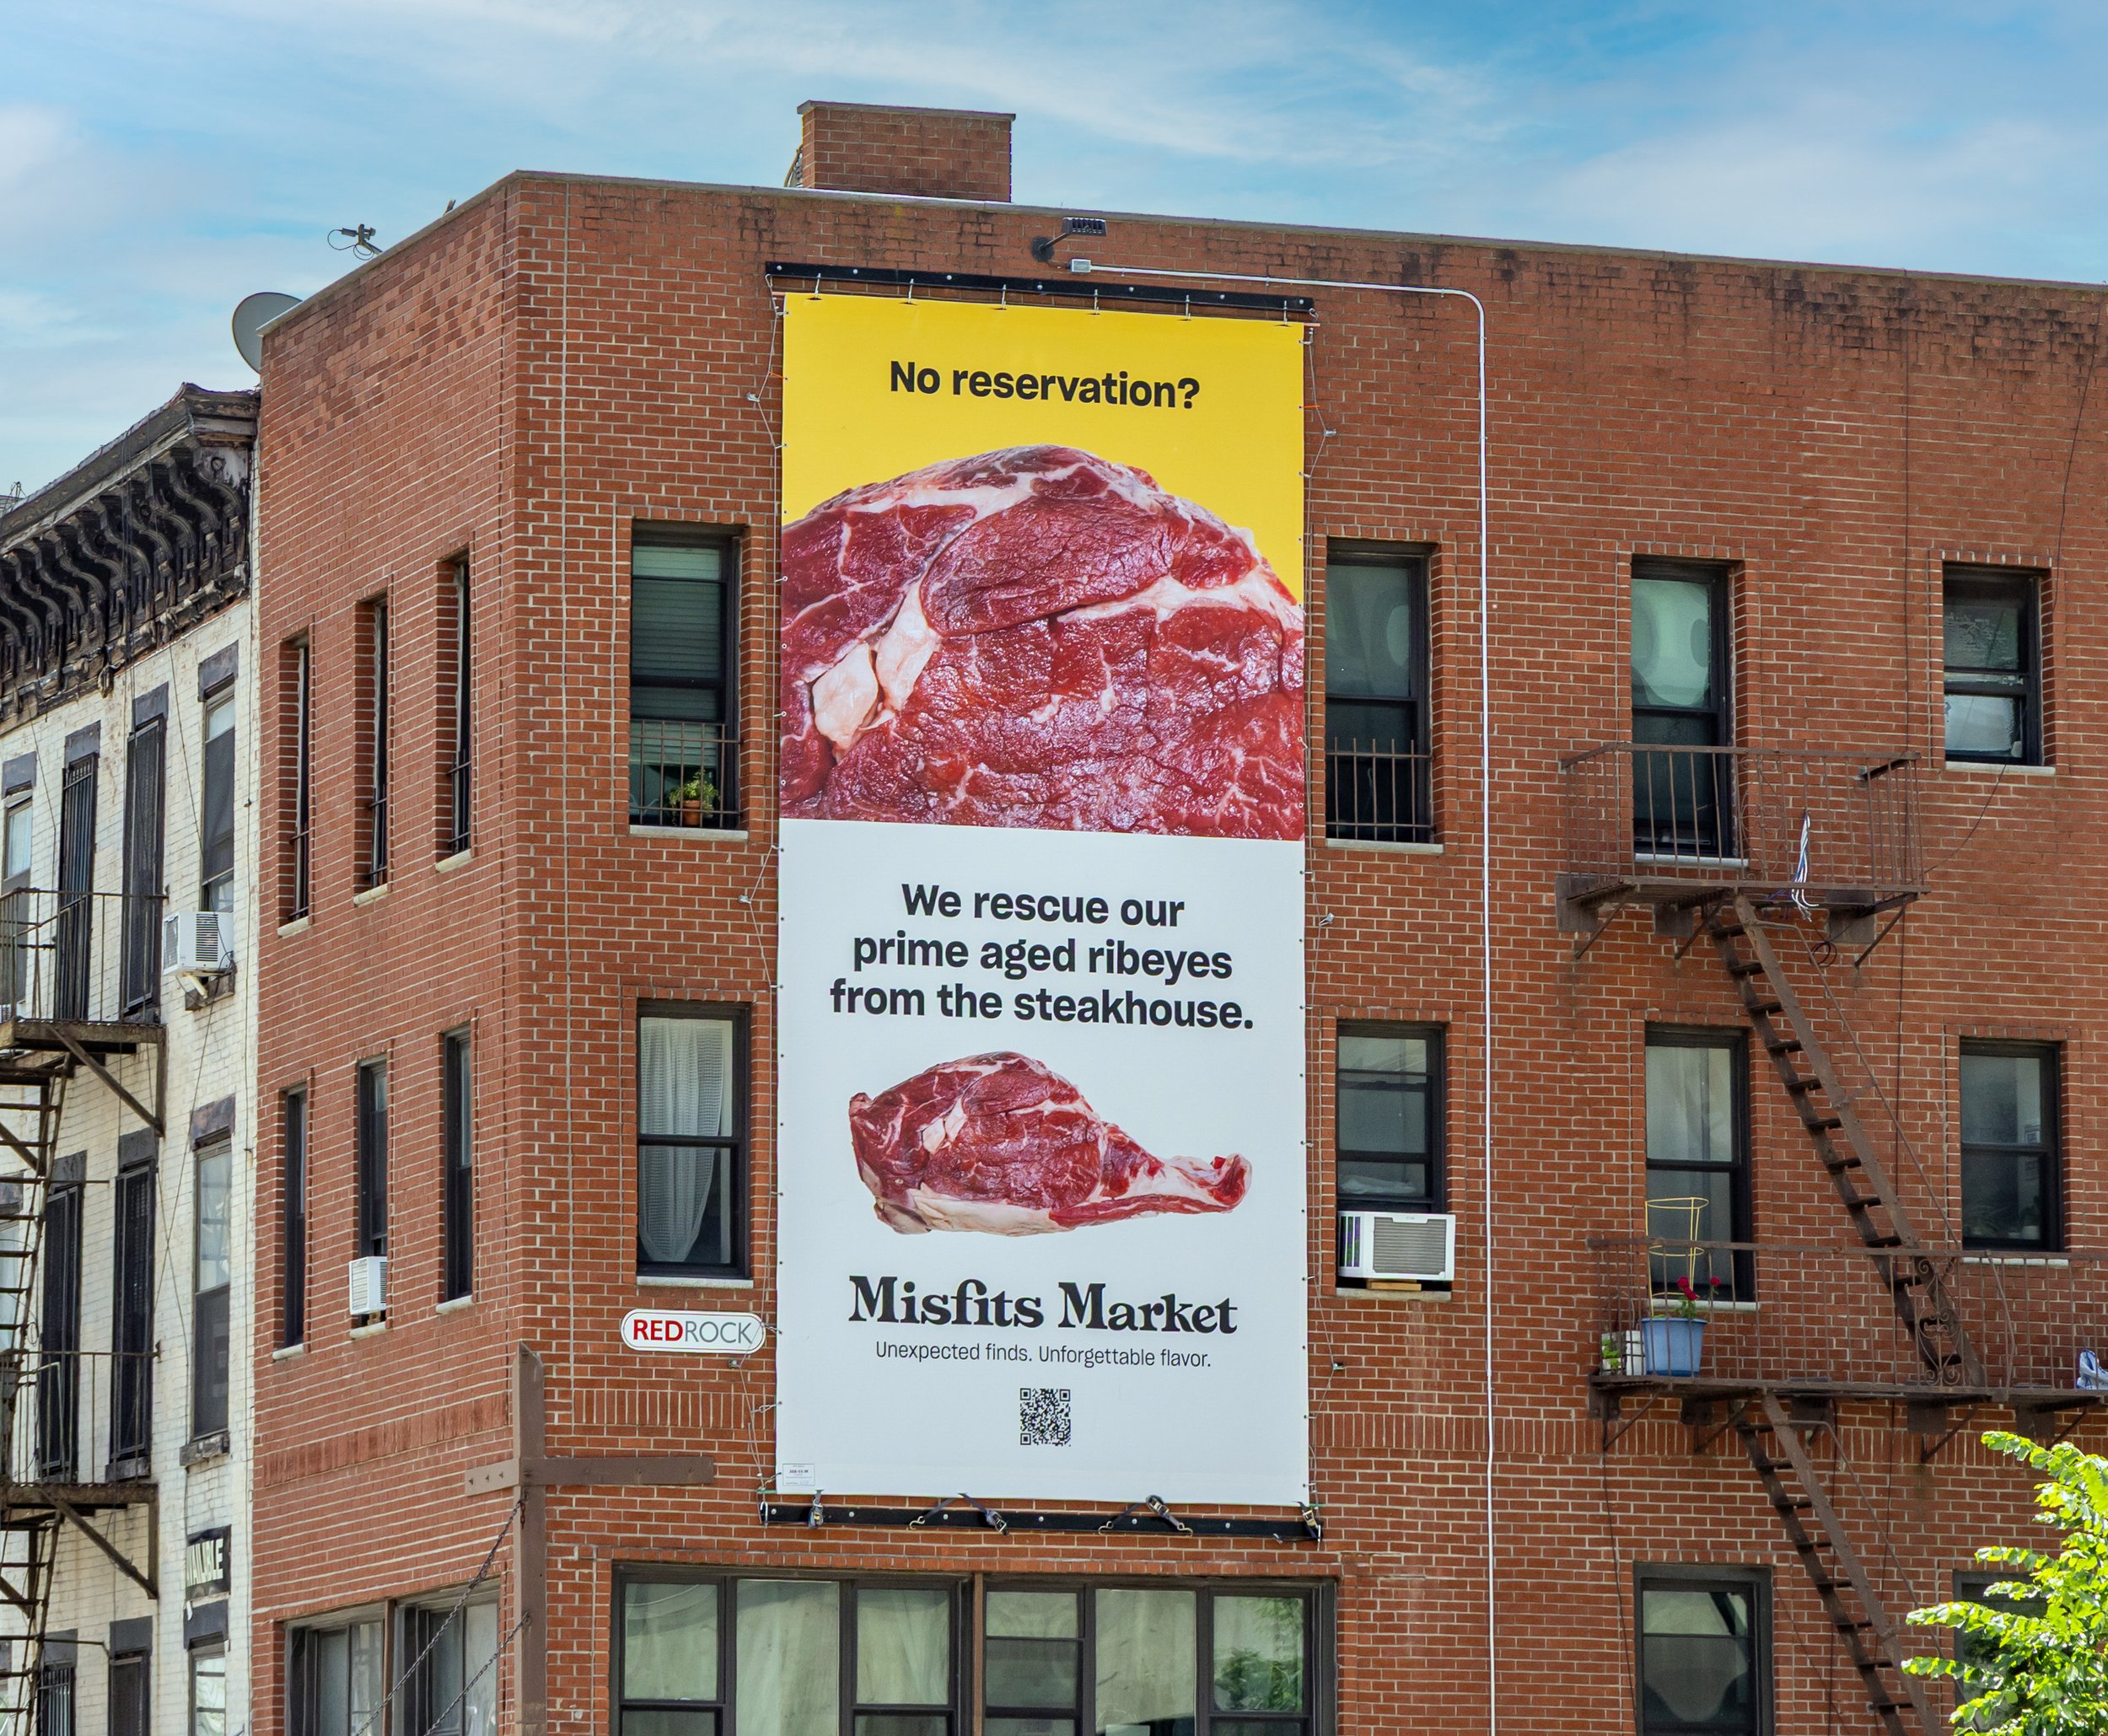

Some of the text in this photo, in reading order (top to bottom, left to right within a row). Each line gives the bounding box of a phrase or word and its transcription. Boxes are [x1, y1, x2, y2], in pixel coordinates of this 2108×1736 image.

[891, 361, 1200, 410] No reservation?
[901, 883, 1185, 927] We rescue our
[853, 930, 1233, 985] prime aged ribeyes
[831, 978, 1254, 1029] from the steakhouse.
[848, 1275, 1238, 1334] Misfits Market
[632, 1319, 753, 1344] REDROCK
[876, 1341, 1211, 1368] Unexpected finds. Unforgettable flavor.
